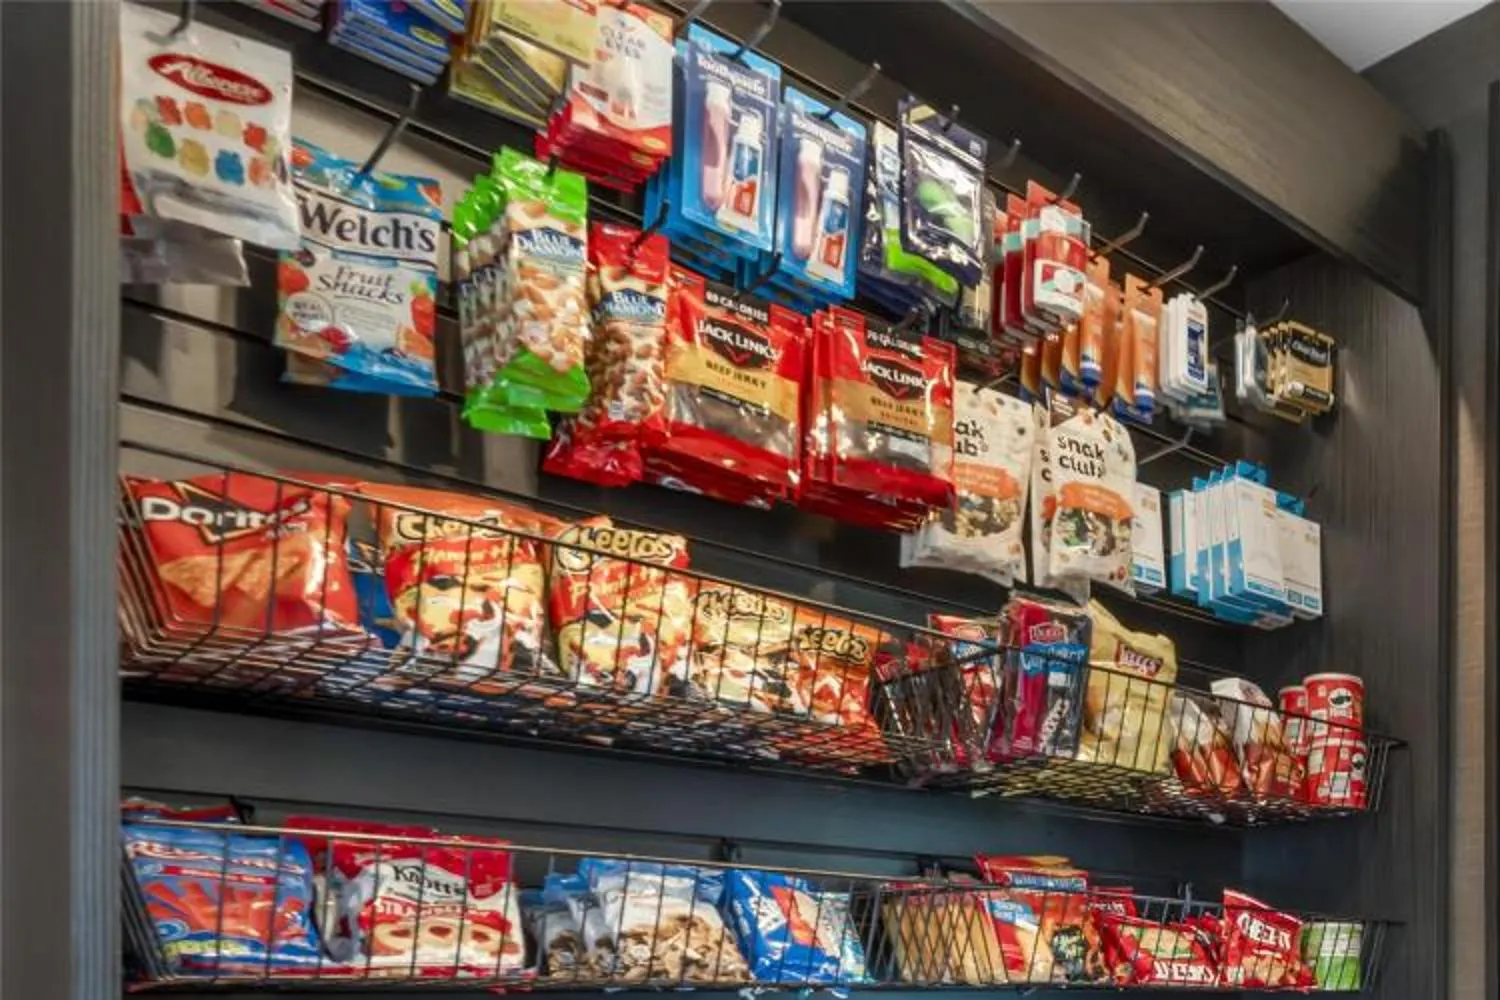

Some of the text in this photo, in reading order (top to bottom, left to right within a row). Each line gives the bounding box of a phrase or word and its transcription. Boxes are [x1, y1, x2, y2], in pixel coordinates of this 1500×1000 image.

[296, 198, 437, 253] Welch's
[316, 274, 405, 305] Snacks
[335, 265, 395, 288] Fruit
[698, 319, 734, 349] JACK
[861, 358, 895, 382] JACK
[955, 419, 984, 440] ak
[1057, 435, 1105, 463] snak
